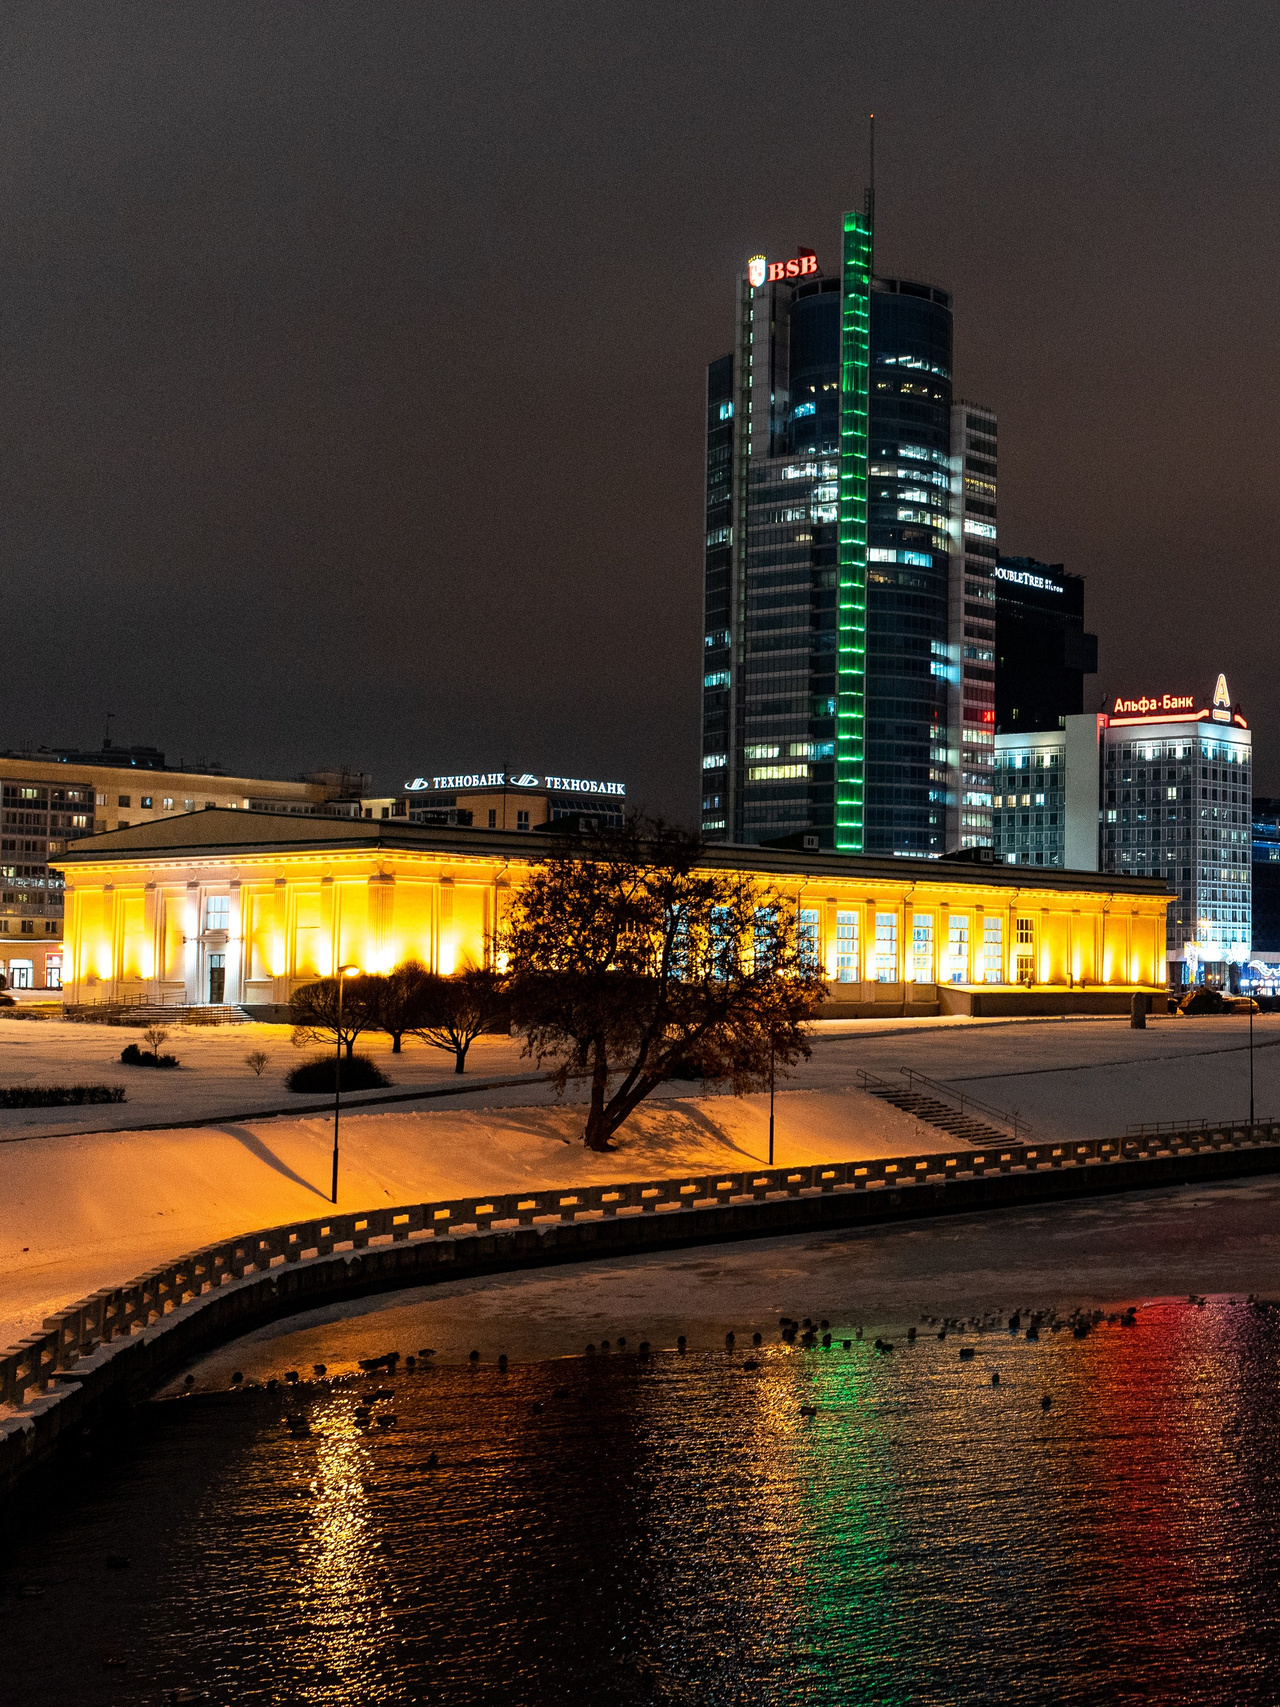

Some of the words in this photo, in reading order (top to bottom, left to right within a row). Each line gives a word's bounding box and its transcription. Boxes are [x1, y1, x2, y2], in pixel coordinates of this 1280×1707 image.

[767, 255, 818, 282] BSB
[433, 773, 505, 789] ТЕХНОБАНК
[545, 776, 626, 795] ТЕХНОБАНК
